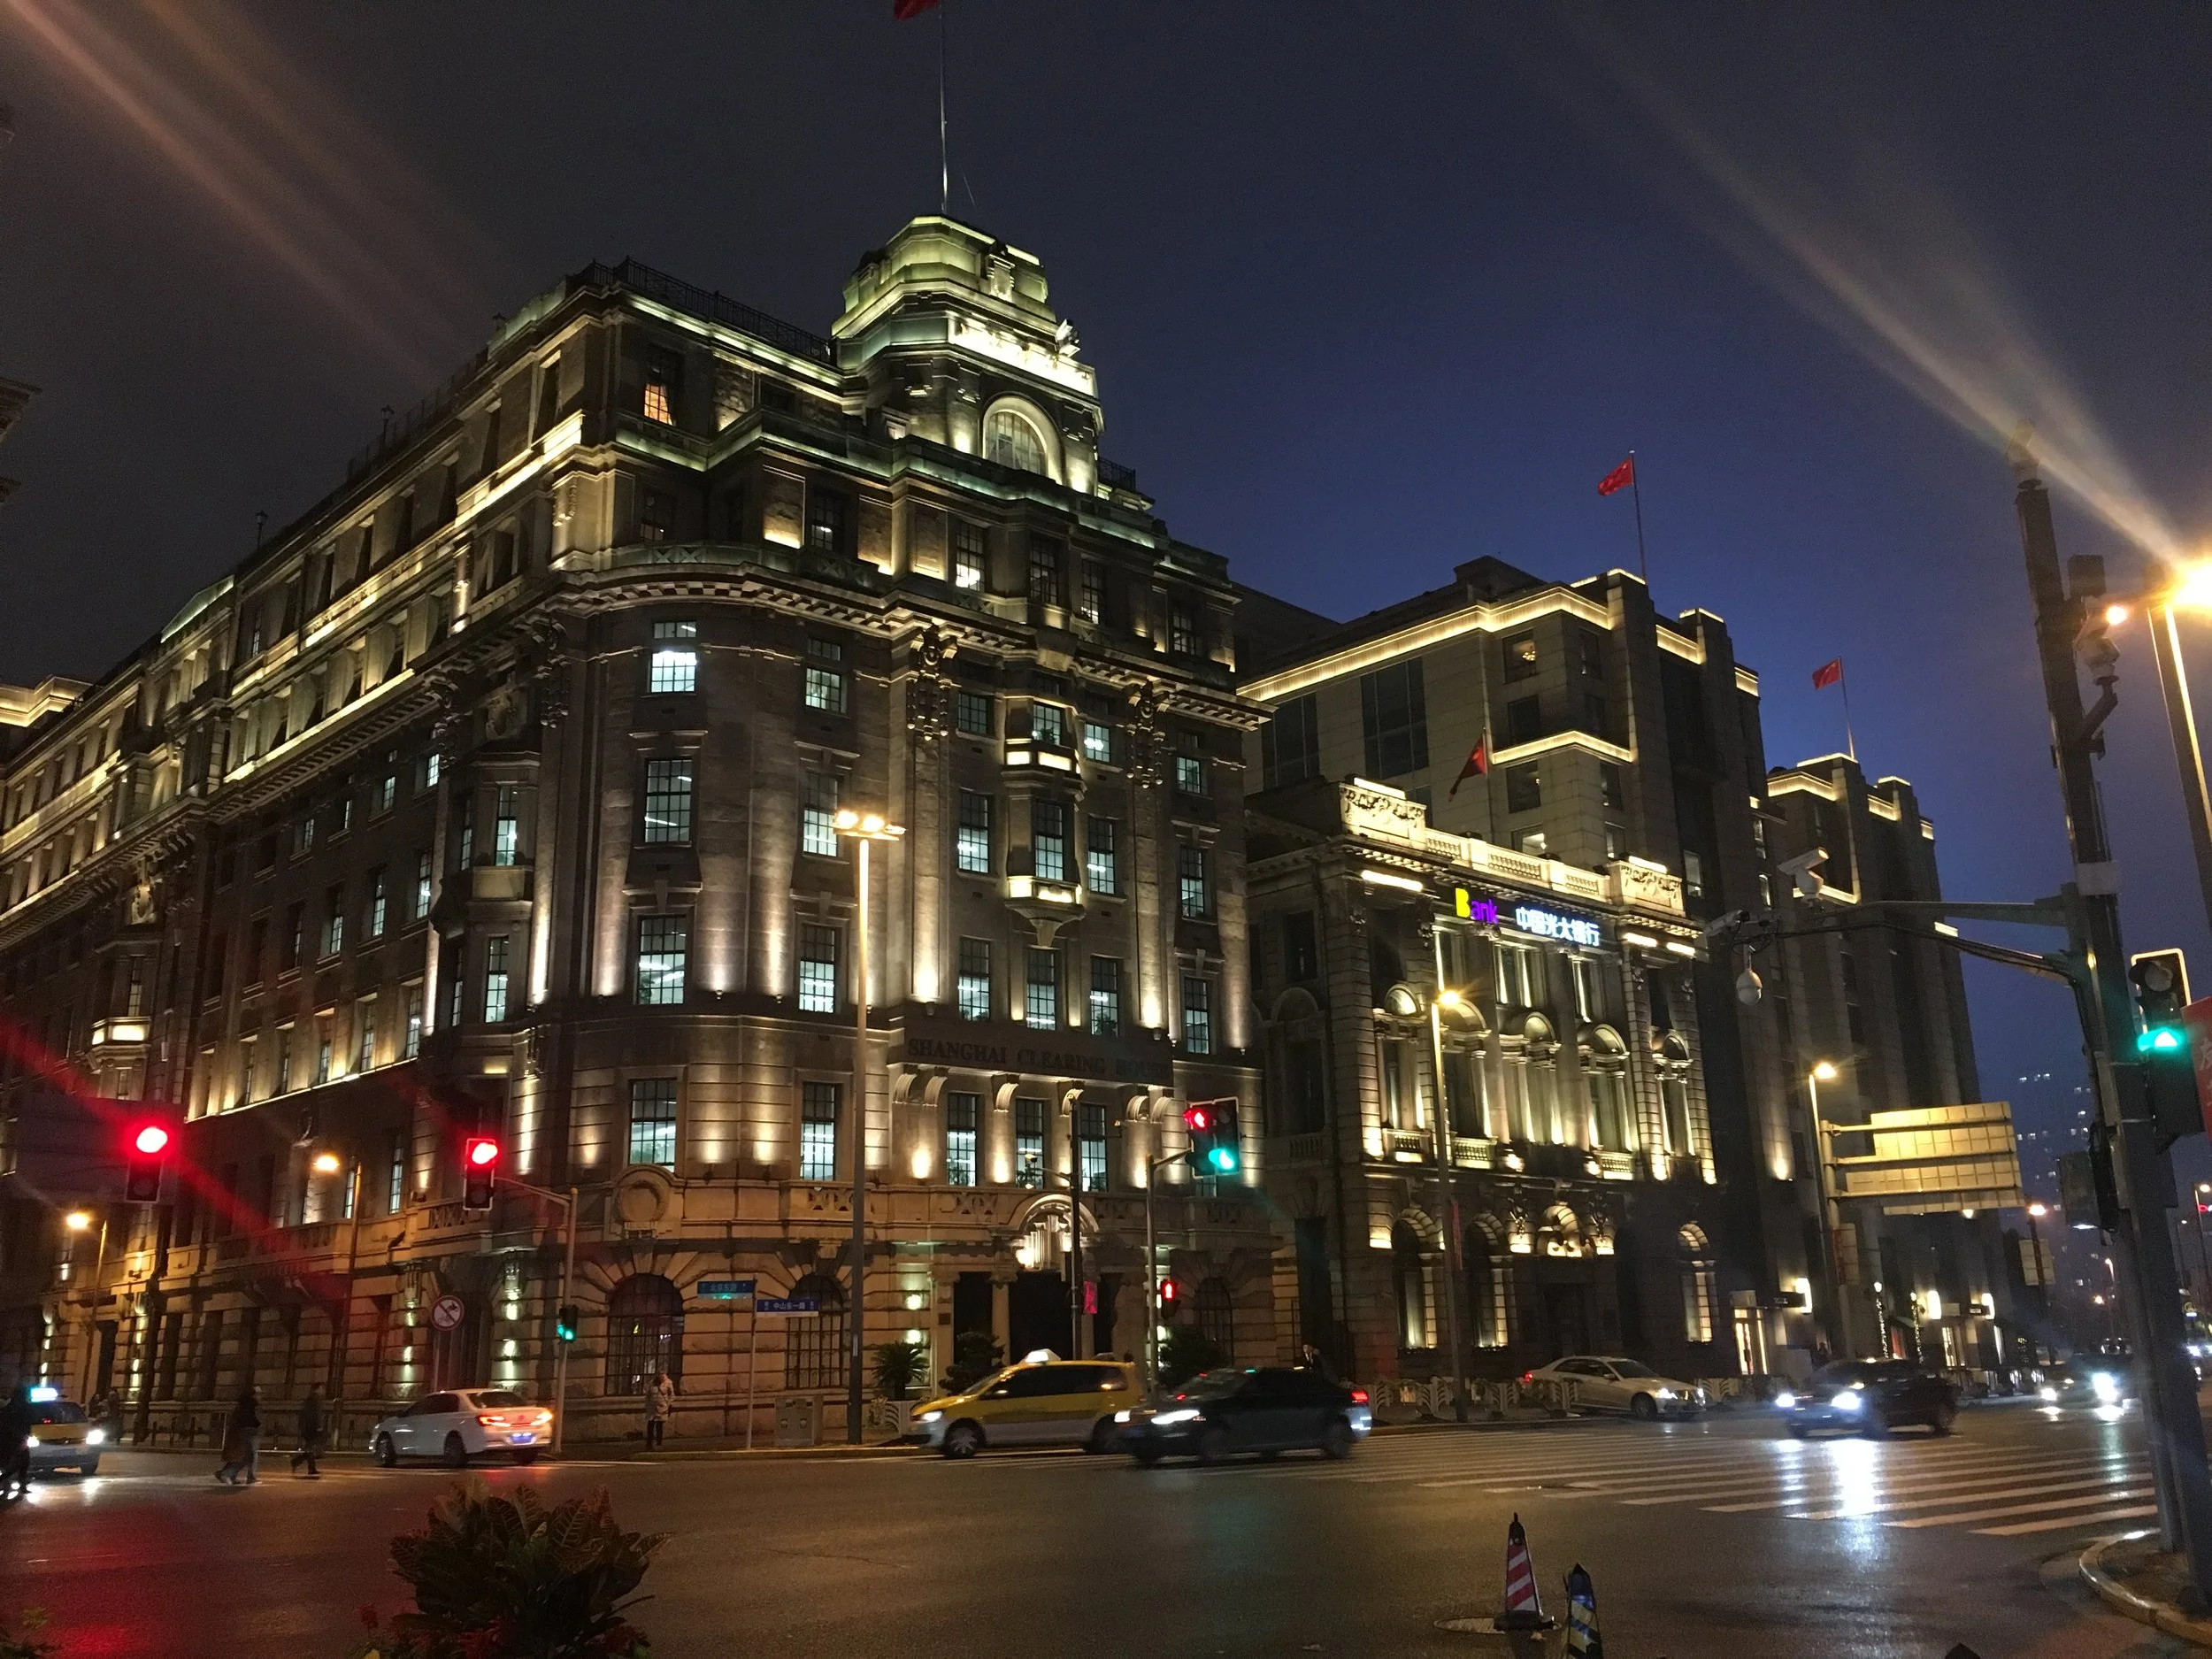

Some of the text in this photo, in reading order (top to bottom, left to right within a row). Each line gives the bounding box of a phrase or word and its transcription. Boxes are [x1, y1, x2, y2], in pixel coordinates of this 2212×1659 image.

[1455, 887, 1499, 924] Bank
[1515, 906, 1600, 947] 中国光大银行
[908, 1038, 1007, 1064] SHANGHAI
[1017, 1048, 1106, 1074] CLEARING
